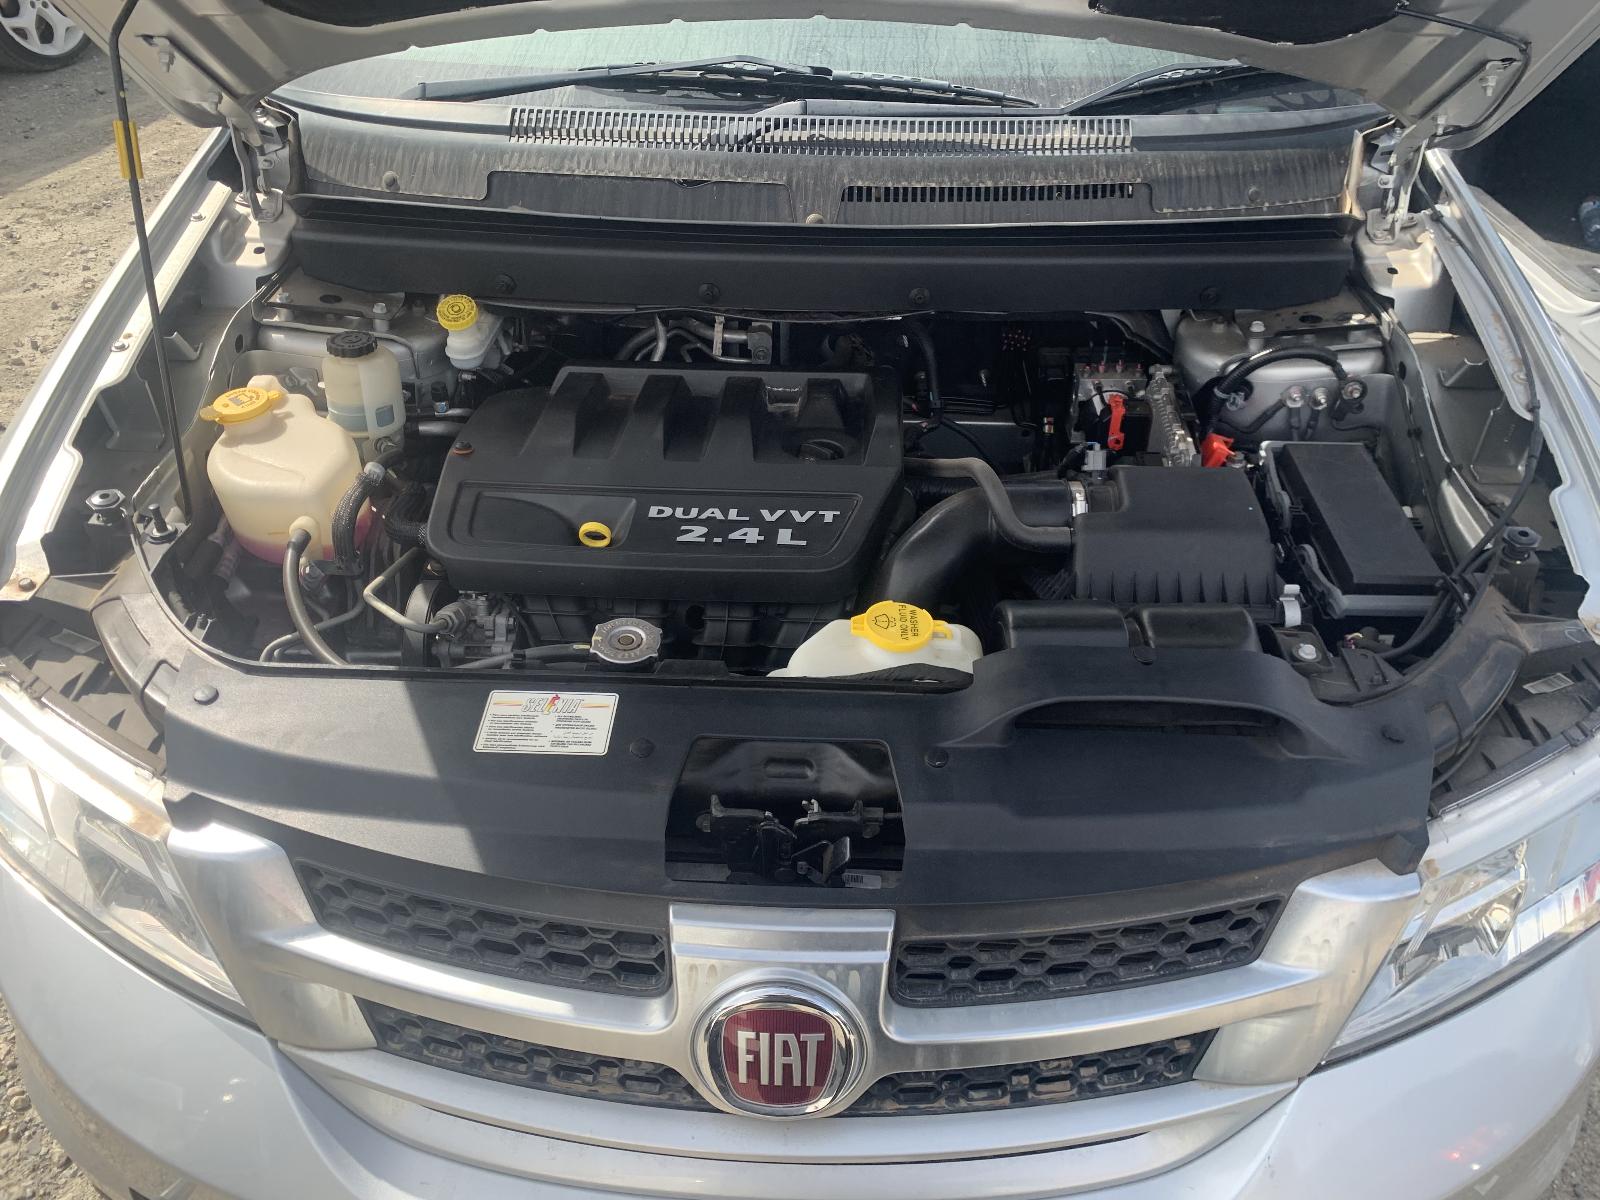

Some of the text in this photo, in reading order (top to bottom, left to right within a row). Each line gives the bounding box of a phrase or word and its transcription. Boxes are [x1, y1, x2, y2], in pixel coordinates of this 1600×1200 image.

[648, 505, 841, 523] DUAL VVT
[676, 525, 807, 546] 2.4 L
[898, 604, 909, 641] FLUID ONLY
[909, 609, 919, 637] WASHER
[737, 1030, 826, 1087] FIAT
